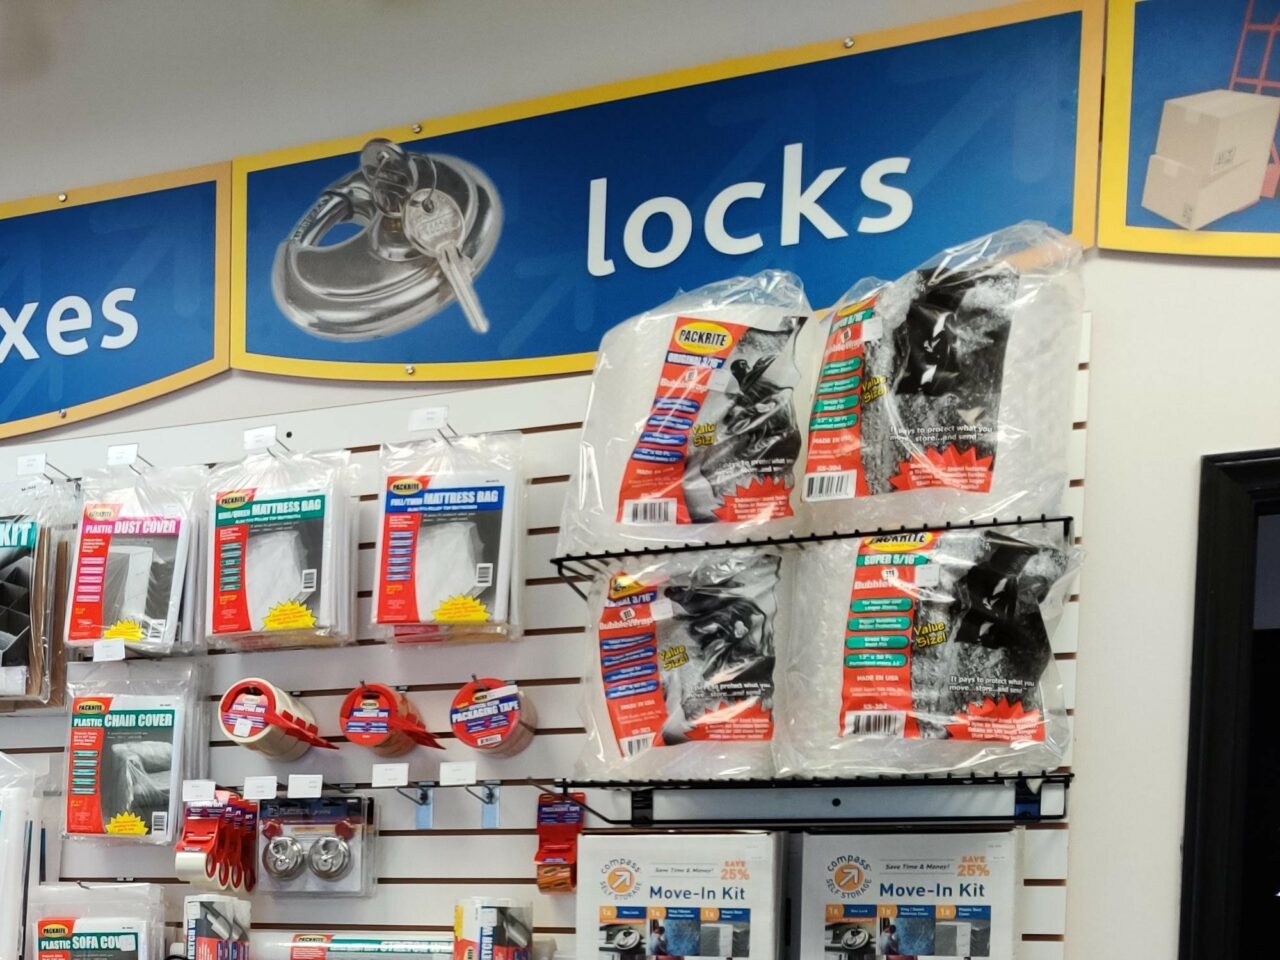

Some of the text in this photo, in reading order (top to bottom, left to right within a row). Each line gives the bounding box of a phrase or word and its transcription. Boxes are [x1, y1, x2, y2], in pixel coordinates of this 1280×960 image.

[586, 142, 913, 277] locks
[680, 330, 727, 346] PACKRITE
[928, 426, 955, 434] protect
[424, 490, 499, 505] MATTRESS BAG
[252, 501, 300, 515] MATTRESS
[301, 499, 321, 511] BAG
[85, 519, 176, 534] PLASTIC DUST COVER
[864, 555, 894, 565] SUPER
[914, 622, 946, 636] Value
[916, 635, 948, 648] Size!
[959, 677, 976, 685] pays
[985, 678, 1007, 686] protect
[452, 700, 520, 723] PACKAGING TAPE
[73, 714, 173, 727] PLASTIC CHAIR COVER
[827, 855, 871, 873] compass
[926, 863, 950, 871] Money!
[957, 865, 990, 877] 25%
[721, 869, 750, 880] 25%
[650, 886, 745, 900] Move-In Kit
[826, 878, 872, 899] SELF STORAGE
[879, 883, 985, 897] Move-In Kit
[41, 935, 124, 950] PLASTIC SOFA COV
